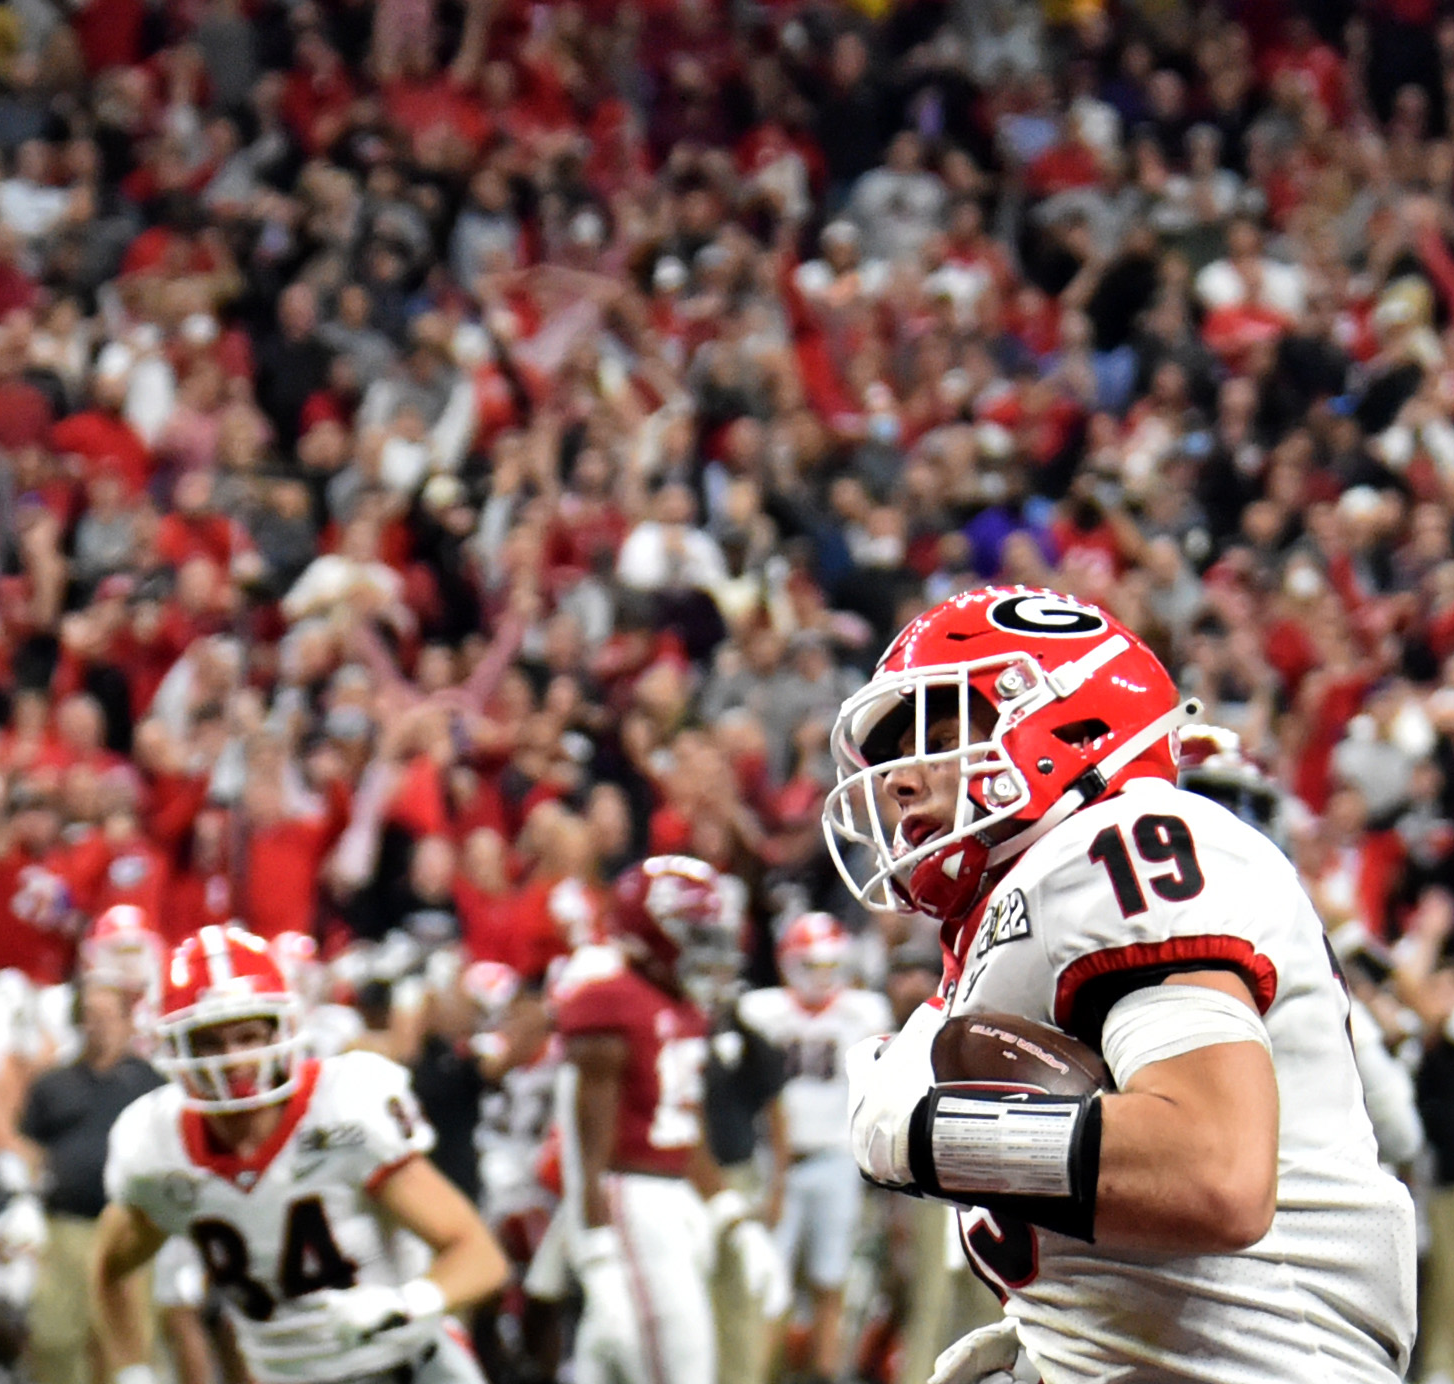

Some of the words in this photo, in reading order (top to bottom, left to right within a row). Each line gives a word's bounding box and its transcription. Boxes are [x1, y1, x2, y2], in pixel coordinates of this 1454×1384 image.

[987, 595, 1107, 638] G
[1088, 814, 1205, 919] 19
[191, 1194, 358, 1322] 84
